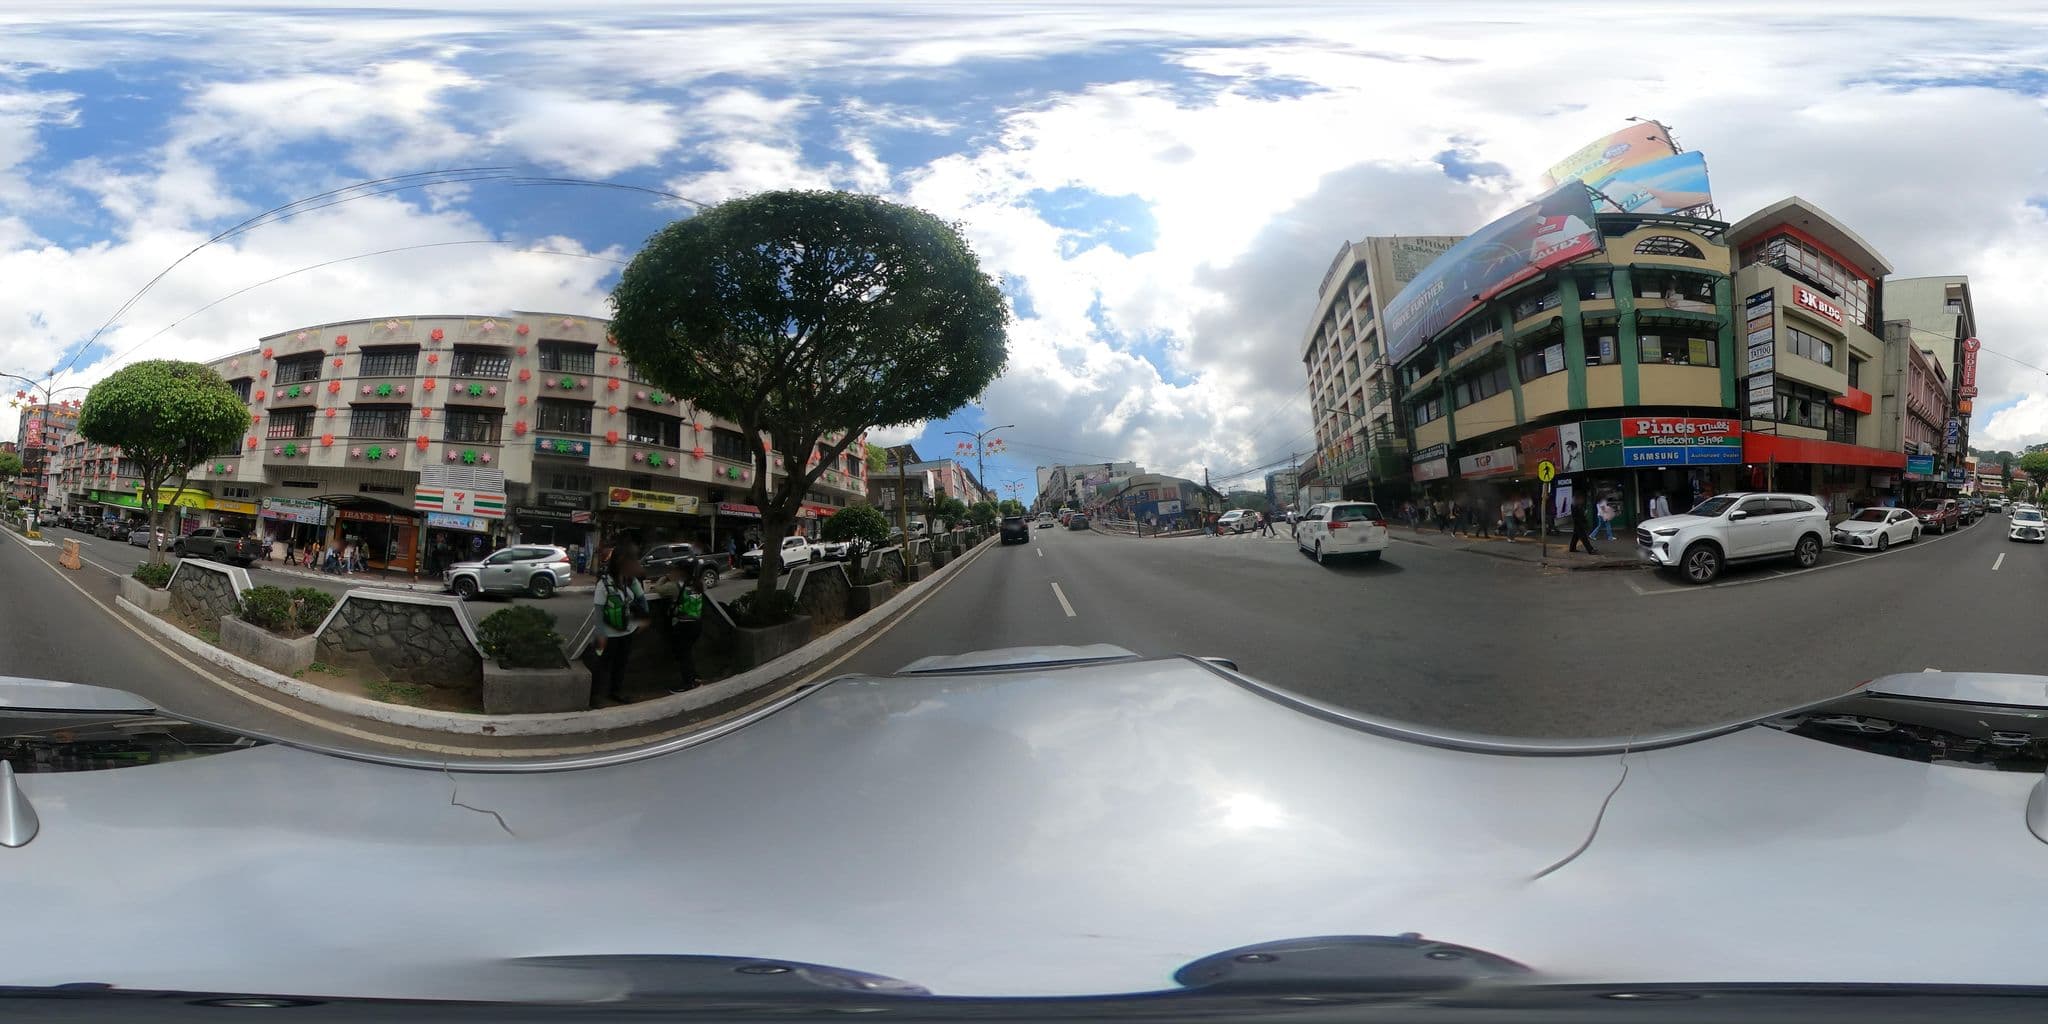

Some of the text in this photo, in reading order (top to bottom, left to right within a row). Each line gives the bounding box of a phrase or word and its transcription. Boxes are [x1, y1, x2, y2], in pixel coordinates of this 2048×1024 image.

[1409, 280, 1445, 316] FURTHER
[1799, 289, 1842, 322] 3K BLDG.
[1636, 419, 1697, 435] Pines
[1650, 435, 1724, 445] Telecom Shop
[1632, 451, 1680, 461] SAMSUNG
